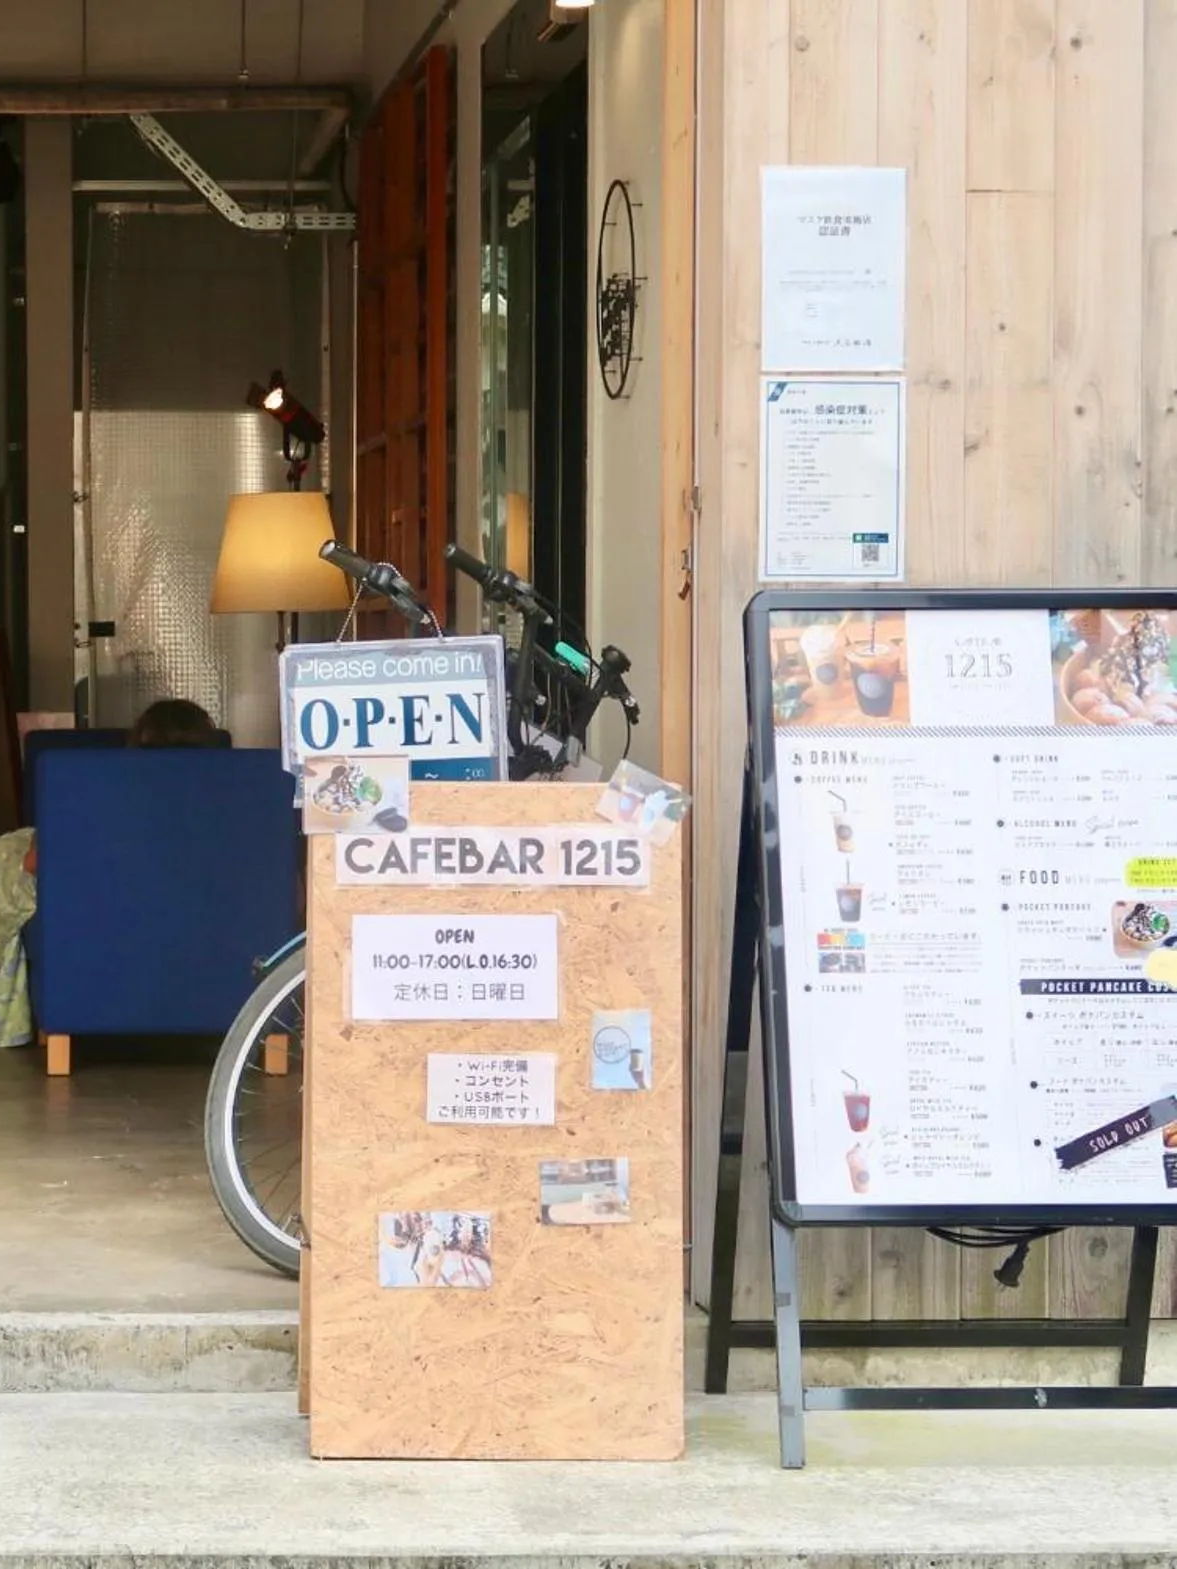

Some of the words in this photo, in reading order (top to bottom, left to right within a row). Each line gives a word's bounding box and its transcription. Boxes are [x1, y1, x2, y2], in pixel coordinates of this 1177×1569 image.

[296, 658, 376, 681] Please
[382, 655, 449, 677] come
[454, 651, 483, 674] in!
[944, 653, 1013, 678] 1215
[810, 750, 858, 765] DRINK
[344, 838, 545, 875] CAFEBAR
[561, 839, 642, 876] 1215
[1019, 870, 1060, 885] FOOD
[435, 929, 476, 944] OPEN
[393, 982, 525, 1001] 定休日：日曜日
[1041, 981, 1084, 993] POCKET
[1090, 981, 1142, 993] PANCAKE
[1089, 1130, 1119, 1153] SOLD
[1124, 1116, 1149, 1136] OUT
